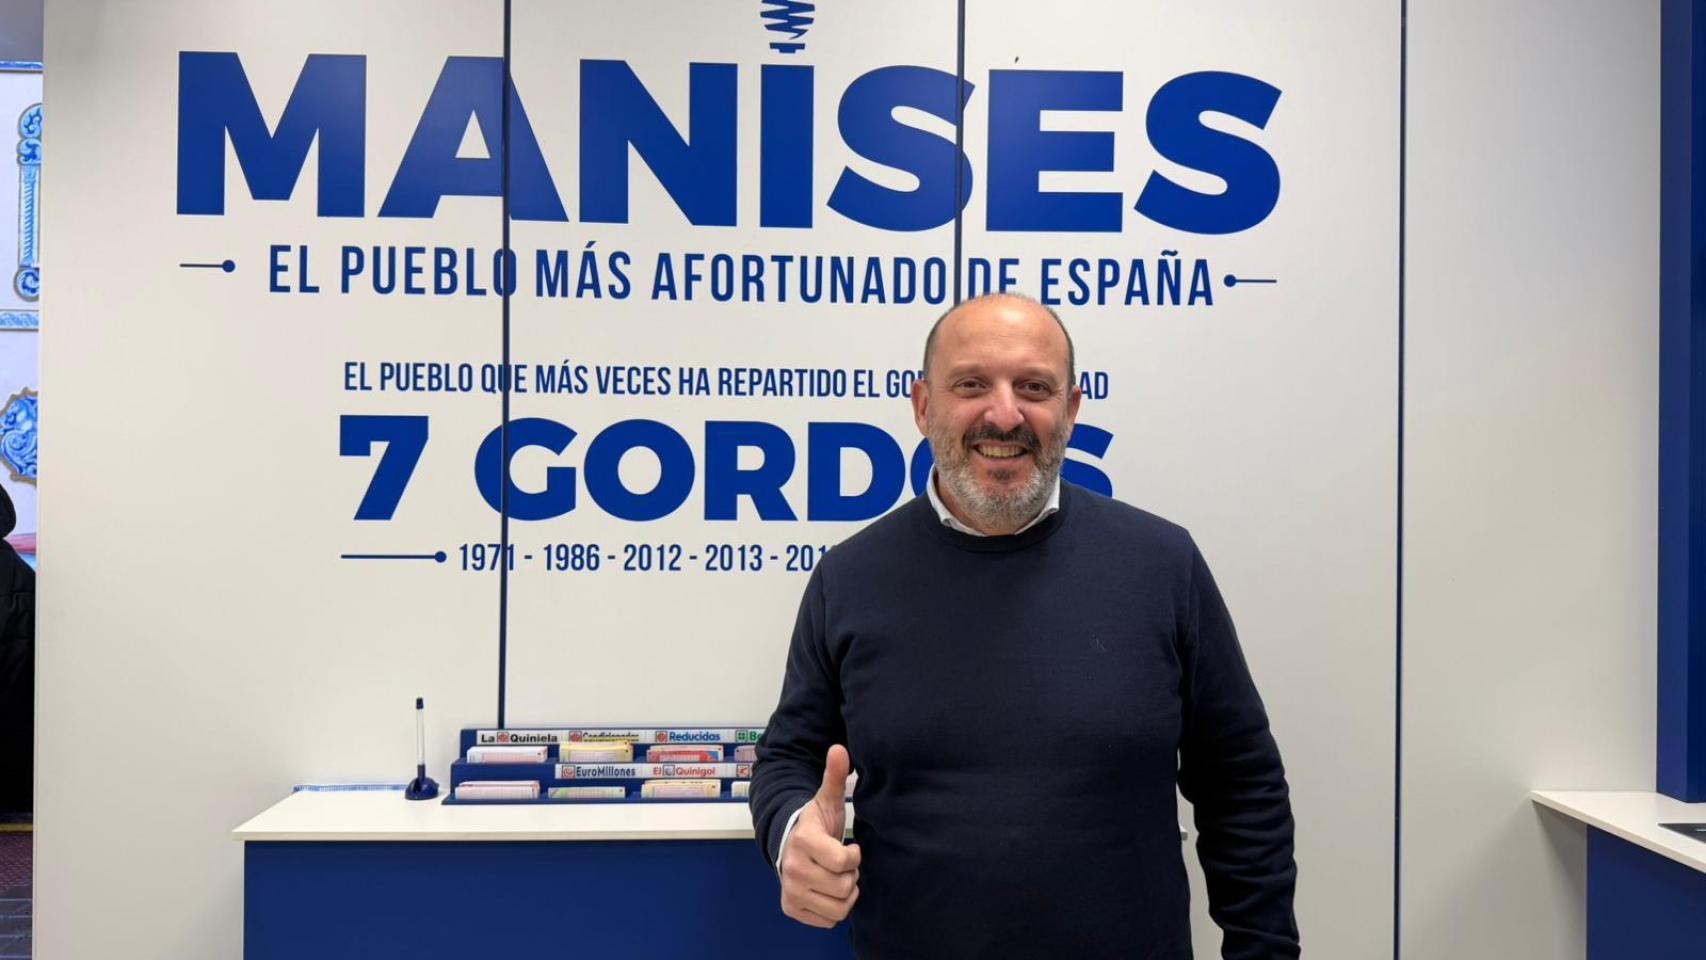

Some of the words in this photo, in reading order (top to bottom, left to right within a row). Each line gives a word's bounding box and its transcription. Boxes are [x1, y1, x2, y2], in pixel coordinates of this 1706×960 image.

[177, 51, 1282, 235] MANISES
[270, 245, 320, 294] EL
[342, 246, 517, 296] PUEBLO
[536, 240, 631, 300] MÁS
[651, 253, 947, 305] AFORTUNADO
[968, 258, 1020, 298] DE
[1041, 249, 1214, 306] ESPAÑA
[345, 362, 372, 391] EL
[380, 362, 473, 392] PUEBLO
[481, 363, 528, 394] QUE
[536, 358, 589, 394] MÁS
[596, 366, 672, 395] VECES
[679, 367, 711, 395] HA
[718, 368, 847, 397] REPARTIDO
[853, 370, 880, 398] EL
[340, 415, 429, 521] 7
[459, 543, 515, 571] 1971
[543, 543, 600, 571] 1986
[624, 543, 682, 571] 2012
[706, 544, 763, 572] 2013
[481, 734, 495, 743] La
[510, 733, 558, 743] Quiniela
[669, 731, 721, 741] Reducidas
[576, 766, 636, 777] EuroMillones
[653, 767, 662, 776] El
[676, 767, 716, 778] Quinigol
